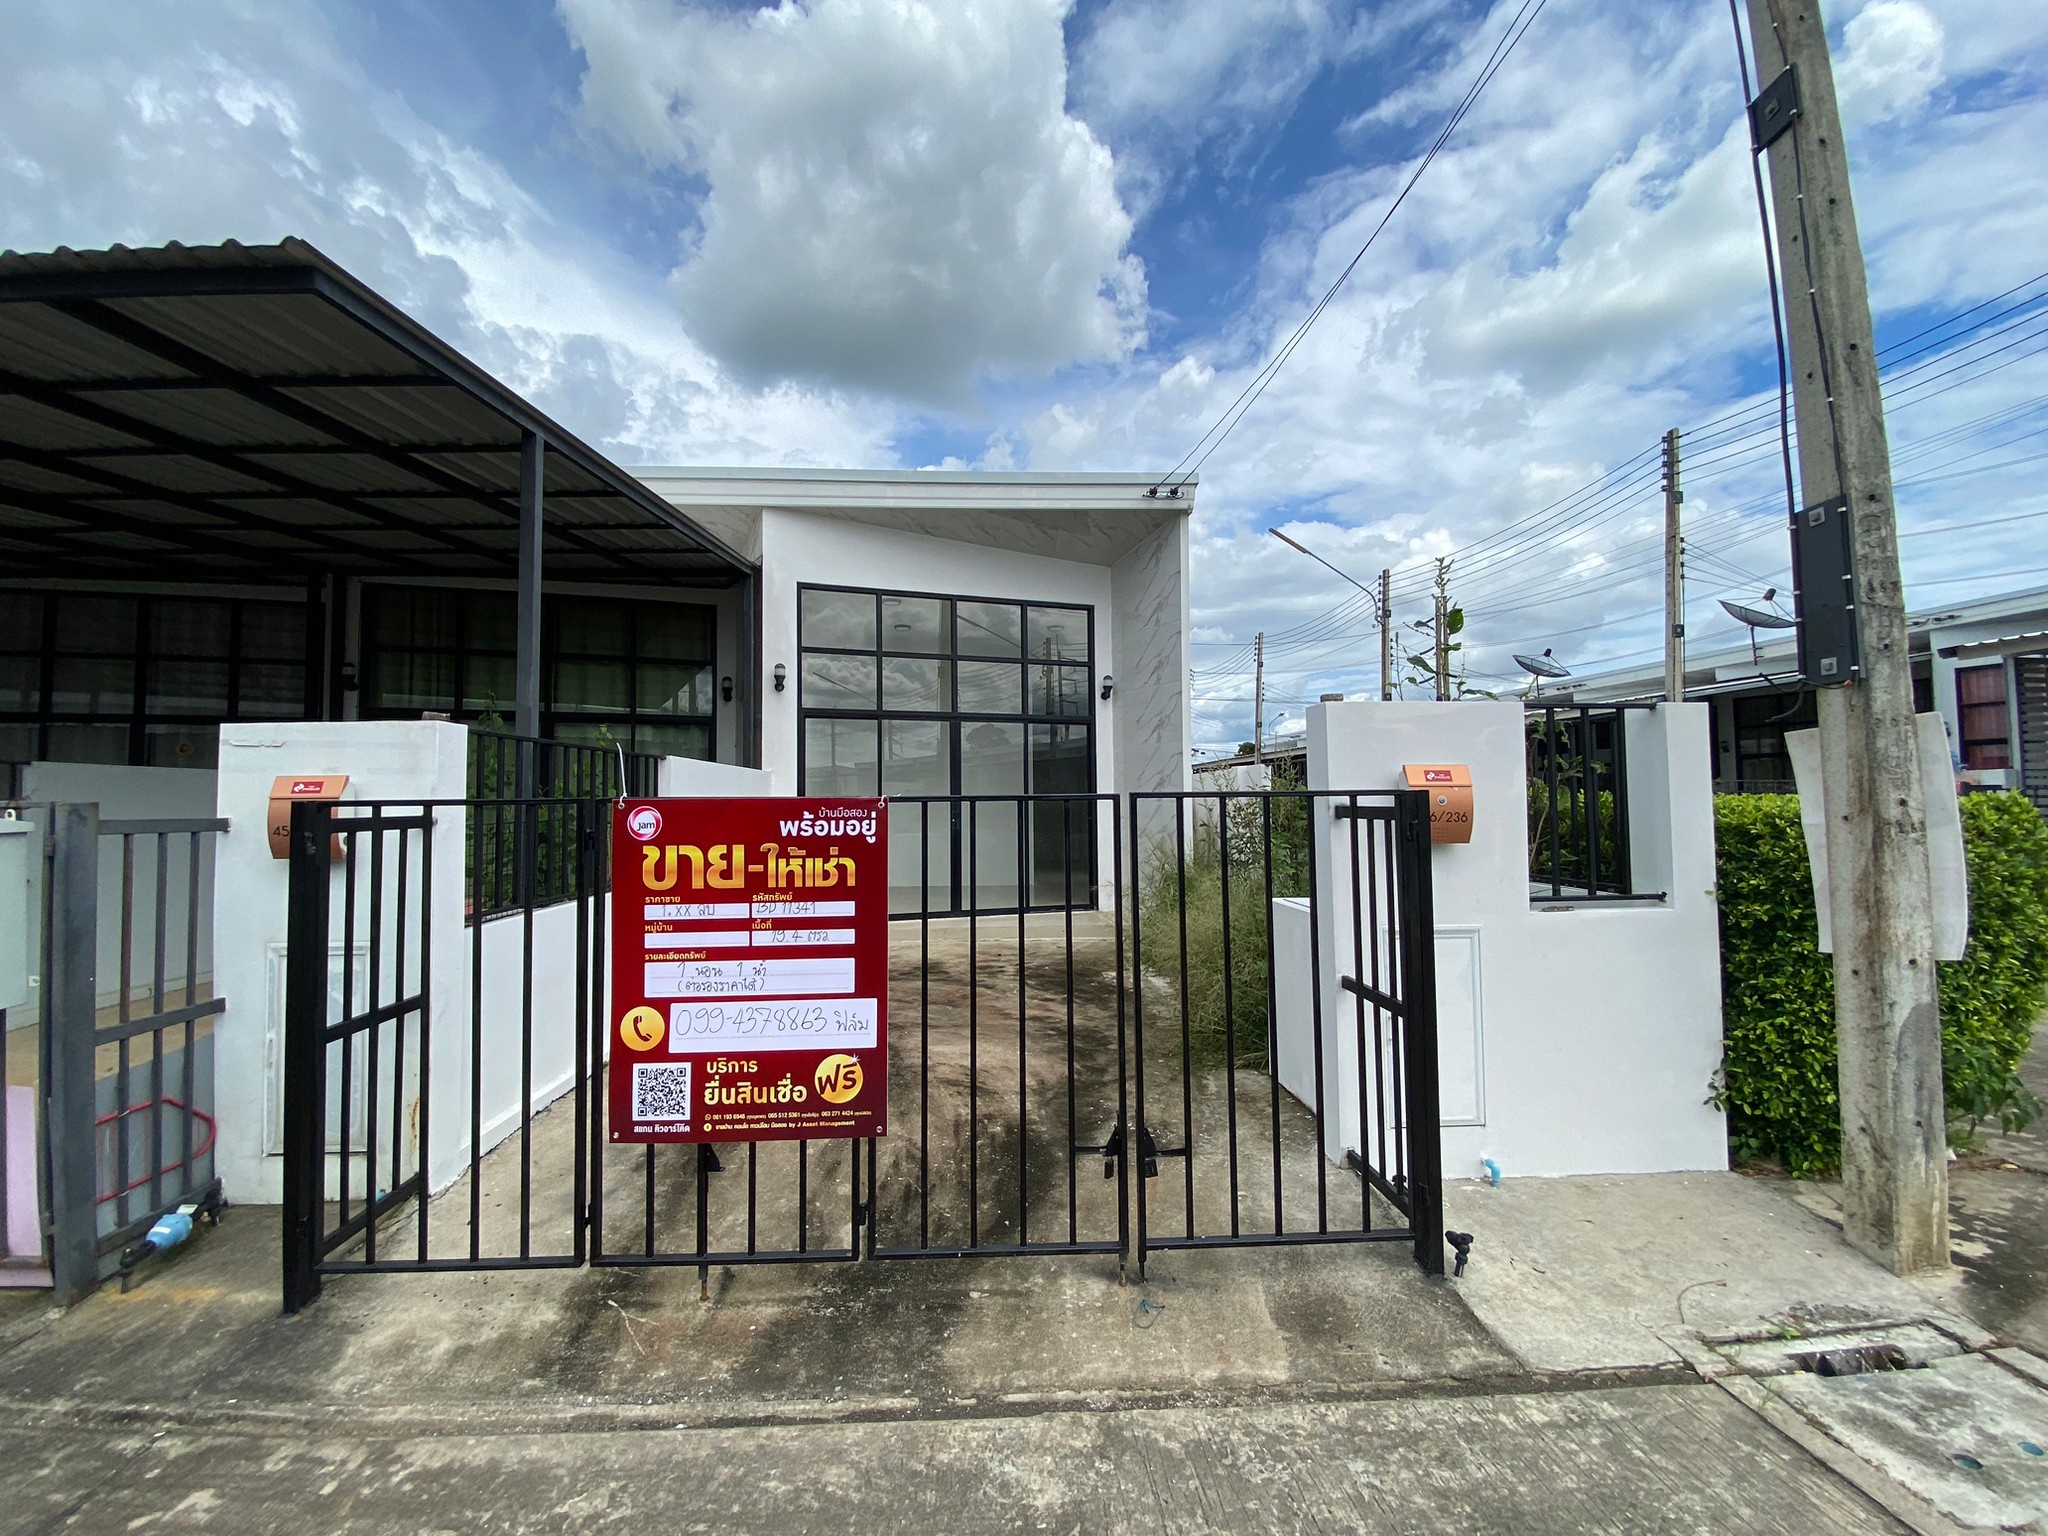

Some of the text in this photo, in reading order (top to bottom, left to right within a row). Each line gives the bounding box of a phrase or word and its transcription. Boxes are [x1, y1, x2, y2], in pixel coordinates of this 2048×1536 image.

[818, 806, 868, 819] บ้านมือสอง
[636, 822, 655, 832] jam
[779, 811, 877, 844] พร้อมอยู่
[645, 896, 681, 904] ราคาขาย
[752, 891, 793, 902] รหัสทรัพย์
[644, 921, 673, 933] หมู่บ้าน
[752, 918, 772, 930] เนื้อที่
[644, 951, 707, 961] รายละเอียดทรัพย์
[677, 961, 686, 978] 1
[695, 965, 723, 978] นอน
[736, 961, 743, 977] 1
[675, 1006, 869, 1036] 099-4378863 ฟิล์ม
[706, 1057, 758, 1074] บริการ
[817, 1062, 861, 1095] ฟรี
[703, 1073, 808, 1106] ยื่นสินเชื่อ
[633, 1125, 653, 1133] สแกน
